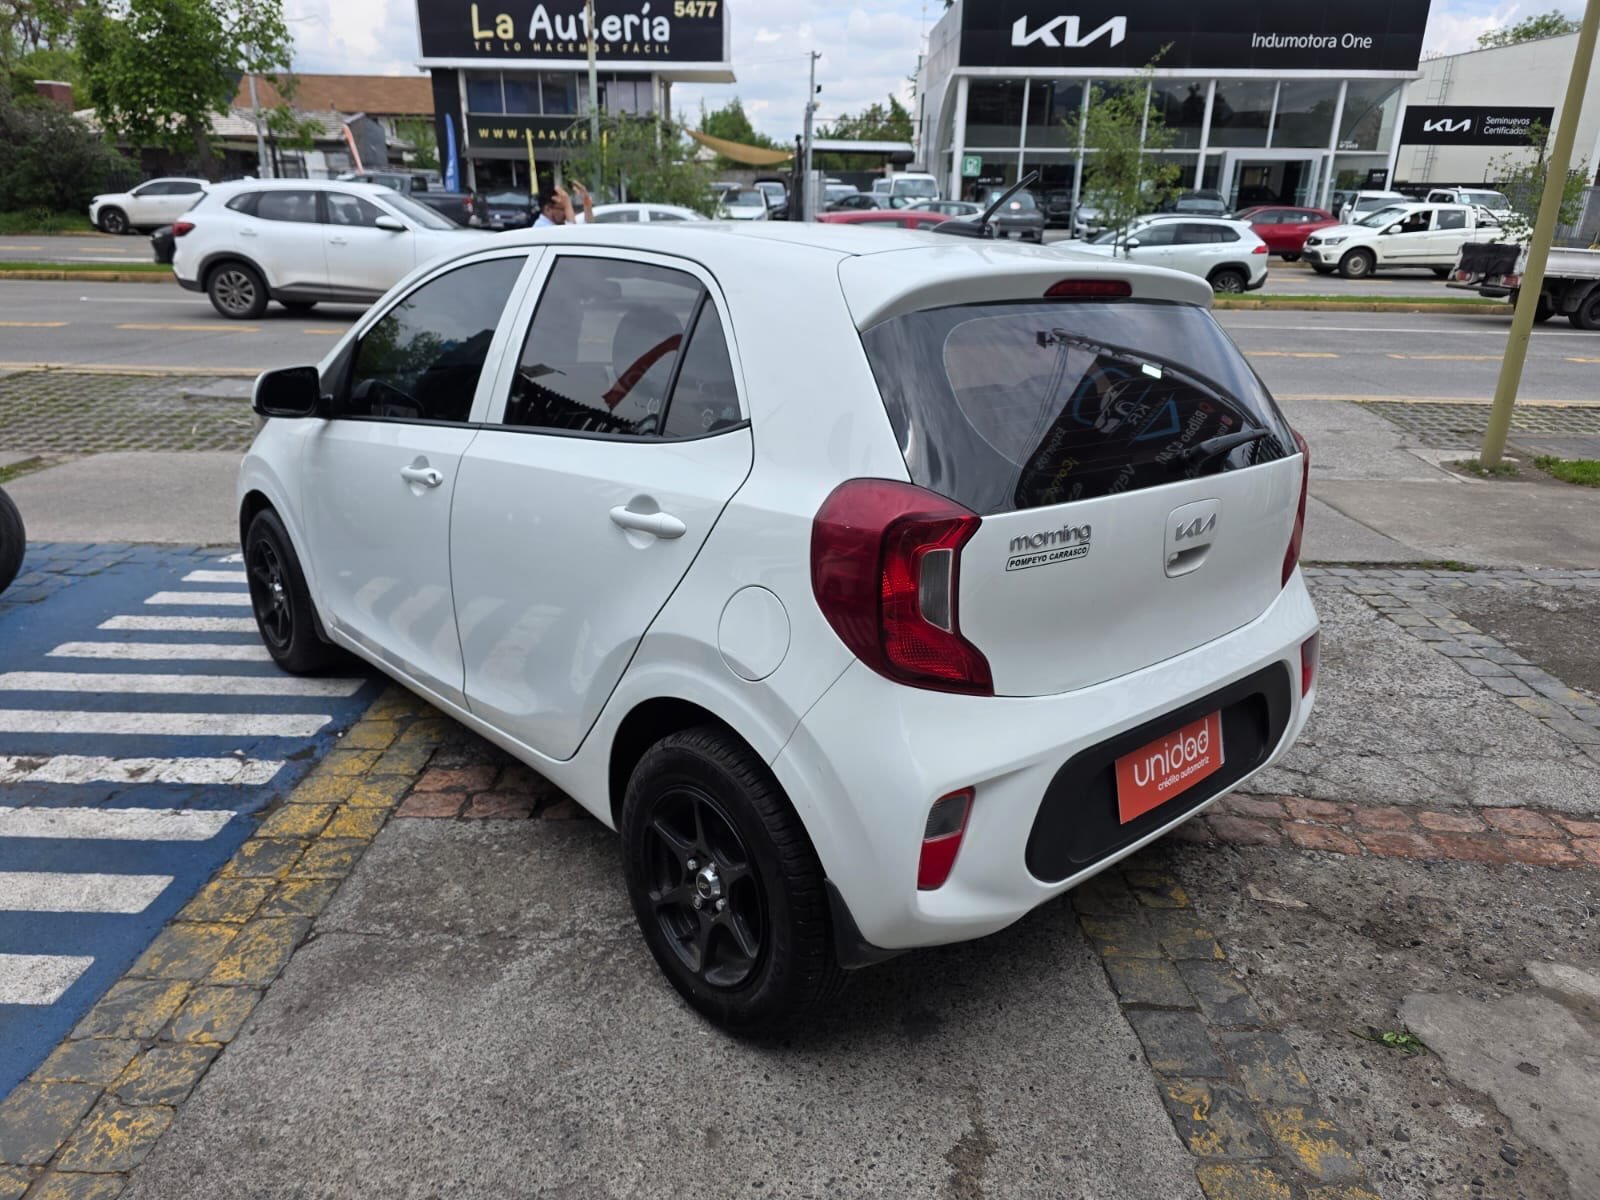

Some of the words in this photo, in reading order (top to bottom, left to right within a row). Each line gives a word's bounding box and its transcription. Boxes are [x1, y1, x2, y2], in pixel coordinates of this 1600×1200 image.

[675, 1, 717, 18] 5477
[471, 3, 514, 39] La
[528, 1, 671, 43] Autería
[1010, 15, 1127, 48] KIA
[474, 41, 492, 52] TE
[503, 41, 521, 52] LO
[533, 42, 611, 54] HACEMOS
[622, 41, 671, 54] FÁCIL
[1251, 32, 1337, 51] Indumotora
[1340, 33, 1372, 51] One
[1424, 118, 1471, 132] KIA
[1483, 125, 1529, 135] Certificados
[1485, 116, 1531, 126] Seminuevos
[1009, 523, 1092, 554] morning
[1174, 512, 1217, 542] KIA
[1009, 553, 1048, 568] POMPEYO
[1048, 545, 1088, 563] CARRASCO
[1135, 720, 1209, 786] unidad
[1158, 773, 1180, 790] crédito
[1180, 757, 1209, 779] automotriz
